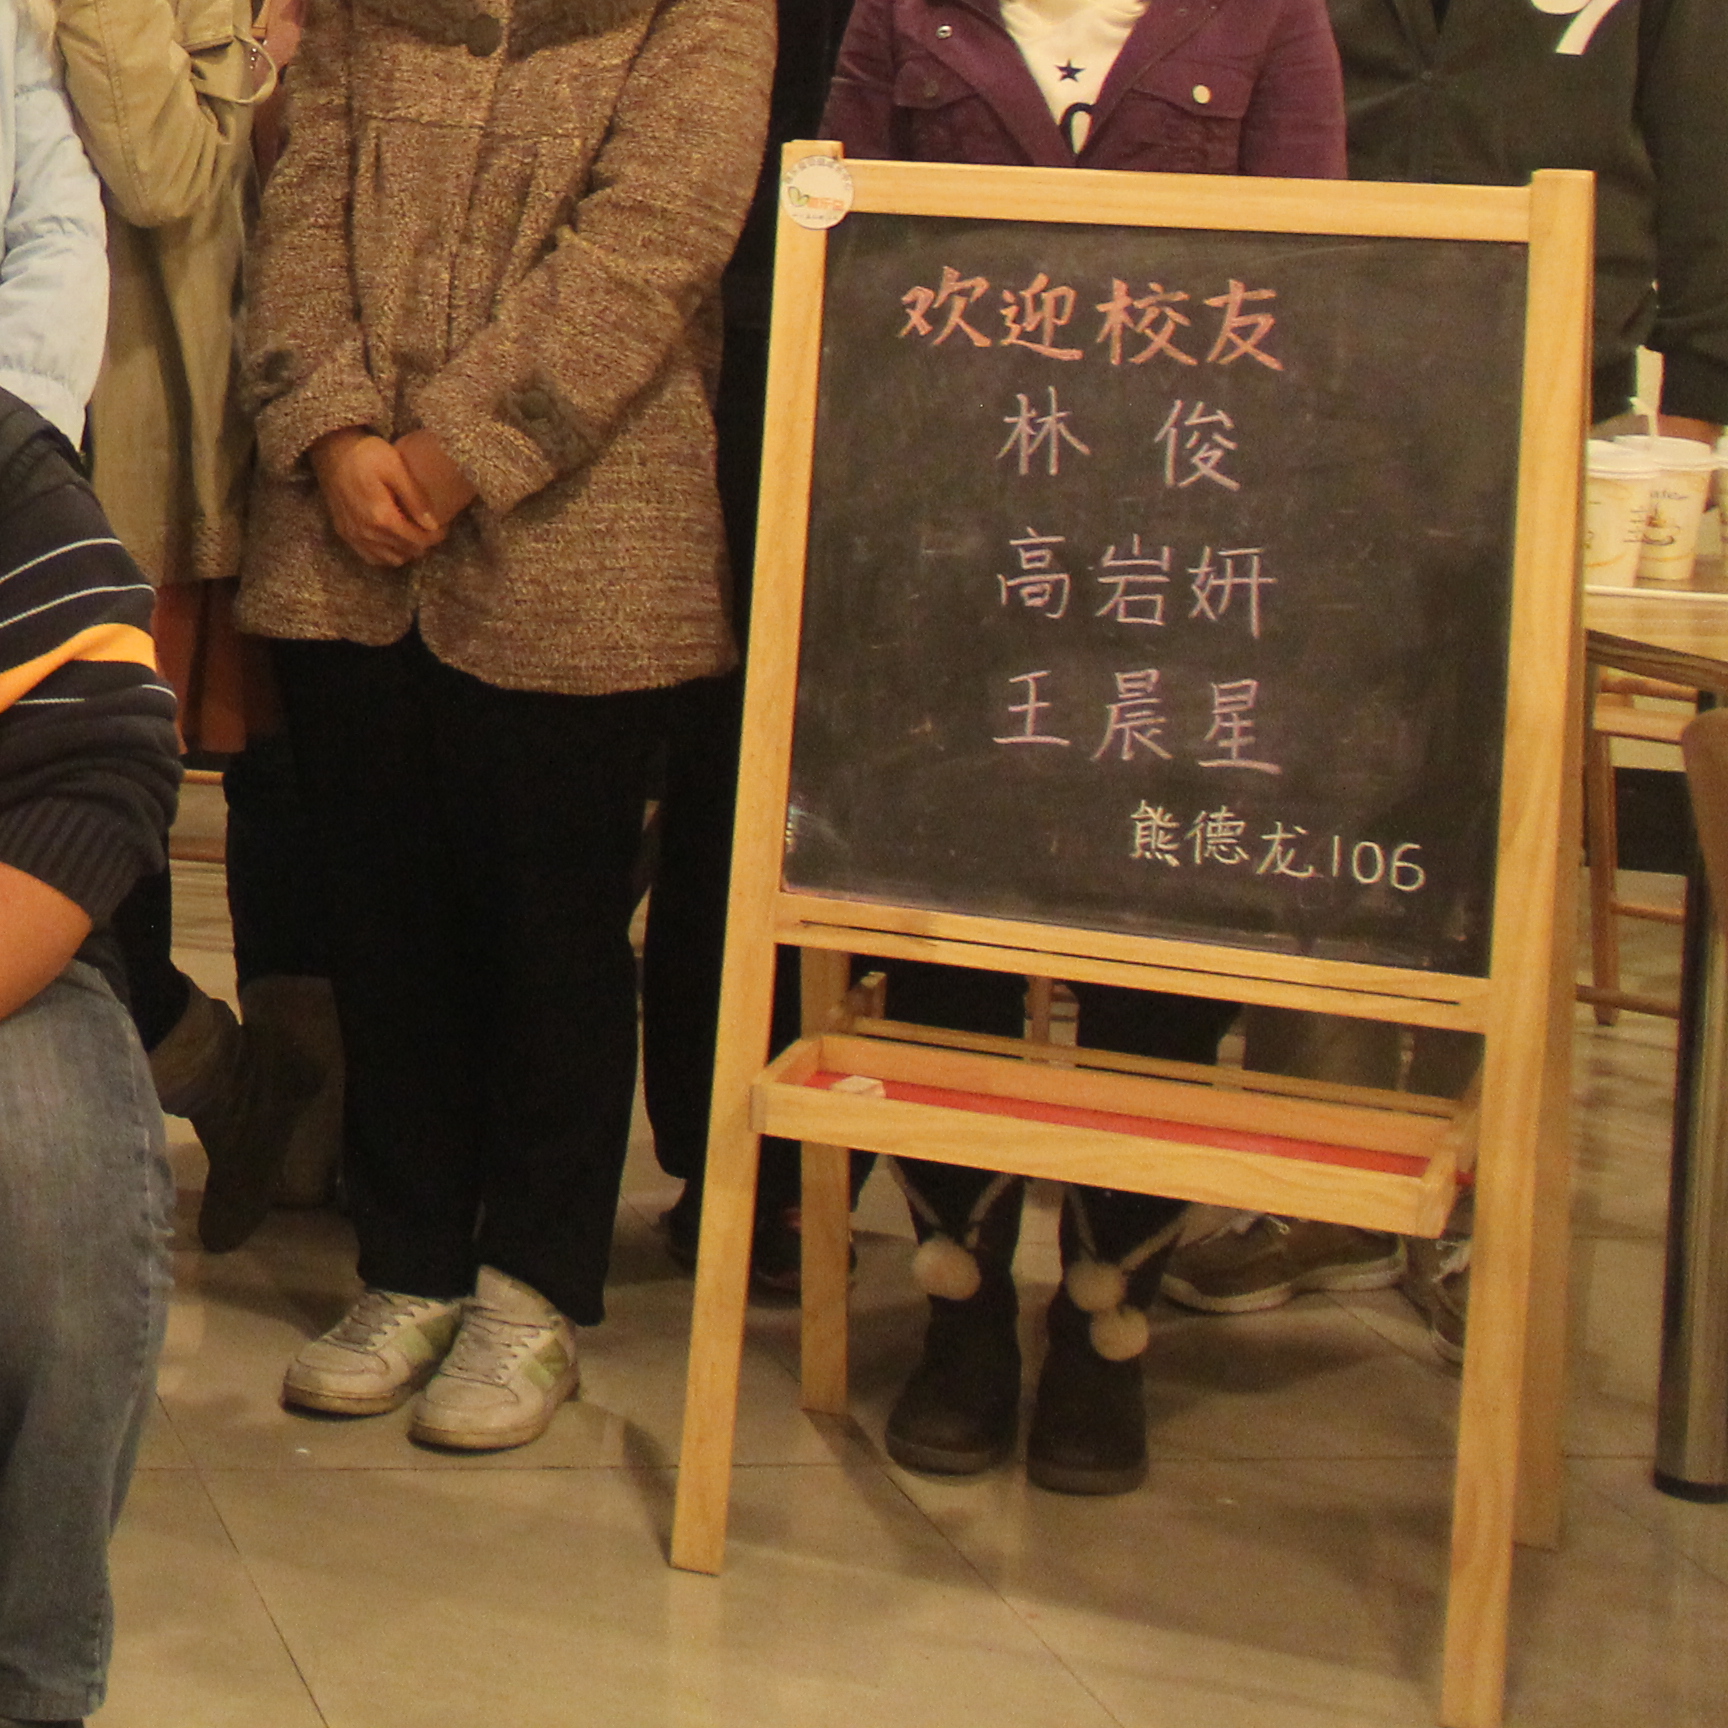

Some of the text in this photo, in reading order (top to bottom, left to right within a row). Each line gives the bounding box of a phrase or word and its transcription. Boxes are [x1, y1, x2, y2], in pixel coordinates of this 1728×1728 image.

[897, 265, 1285, 372] 欢迎校友
[995, 527, 1278, 640] 高岩妍
[992, 668, 1283, 776] 王晨星
